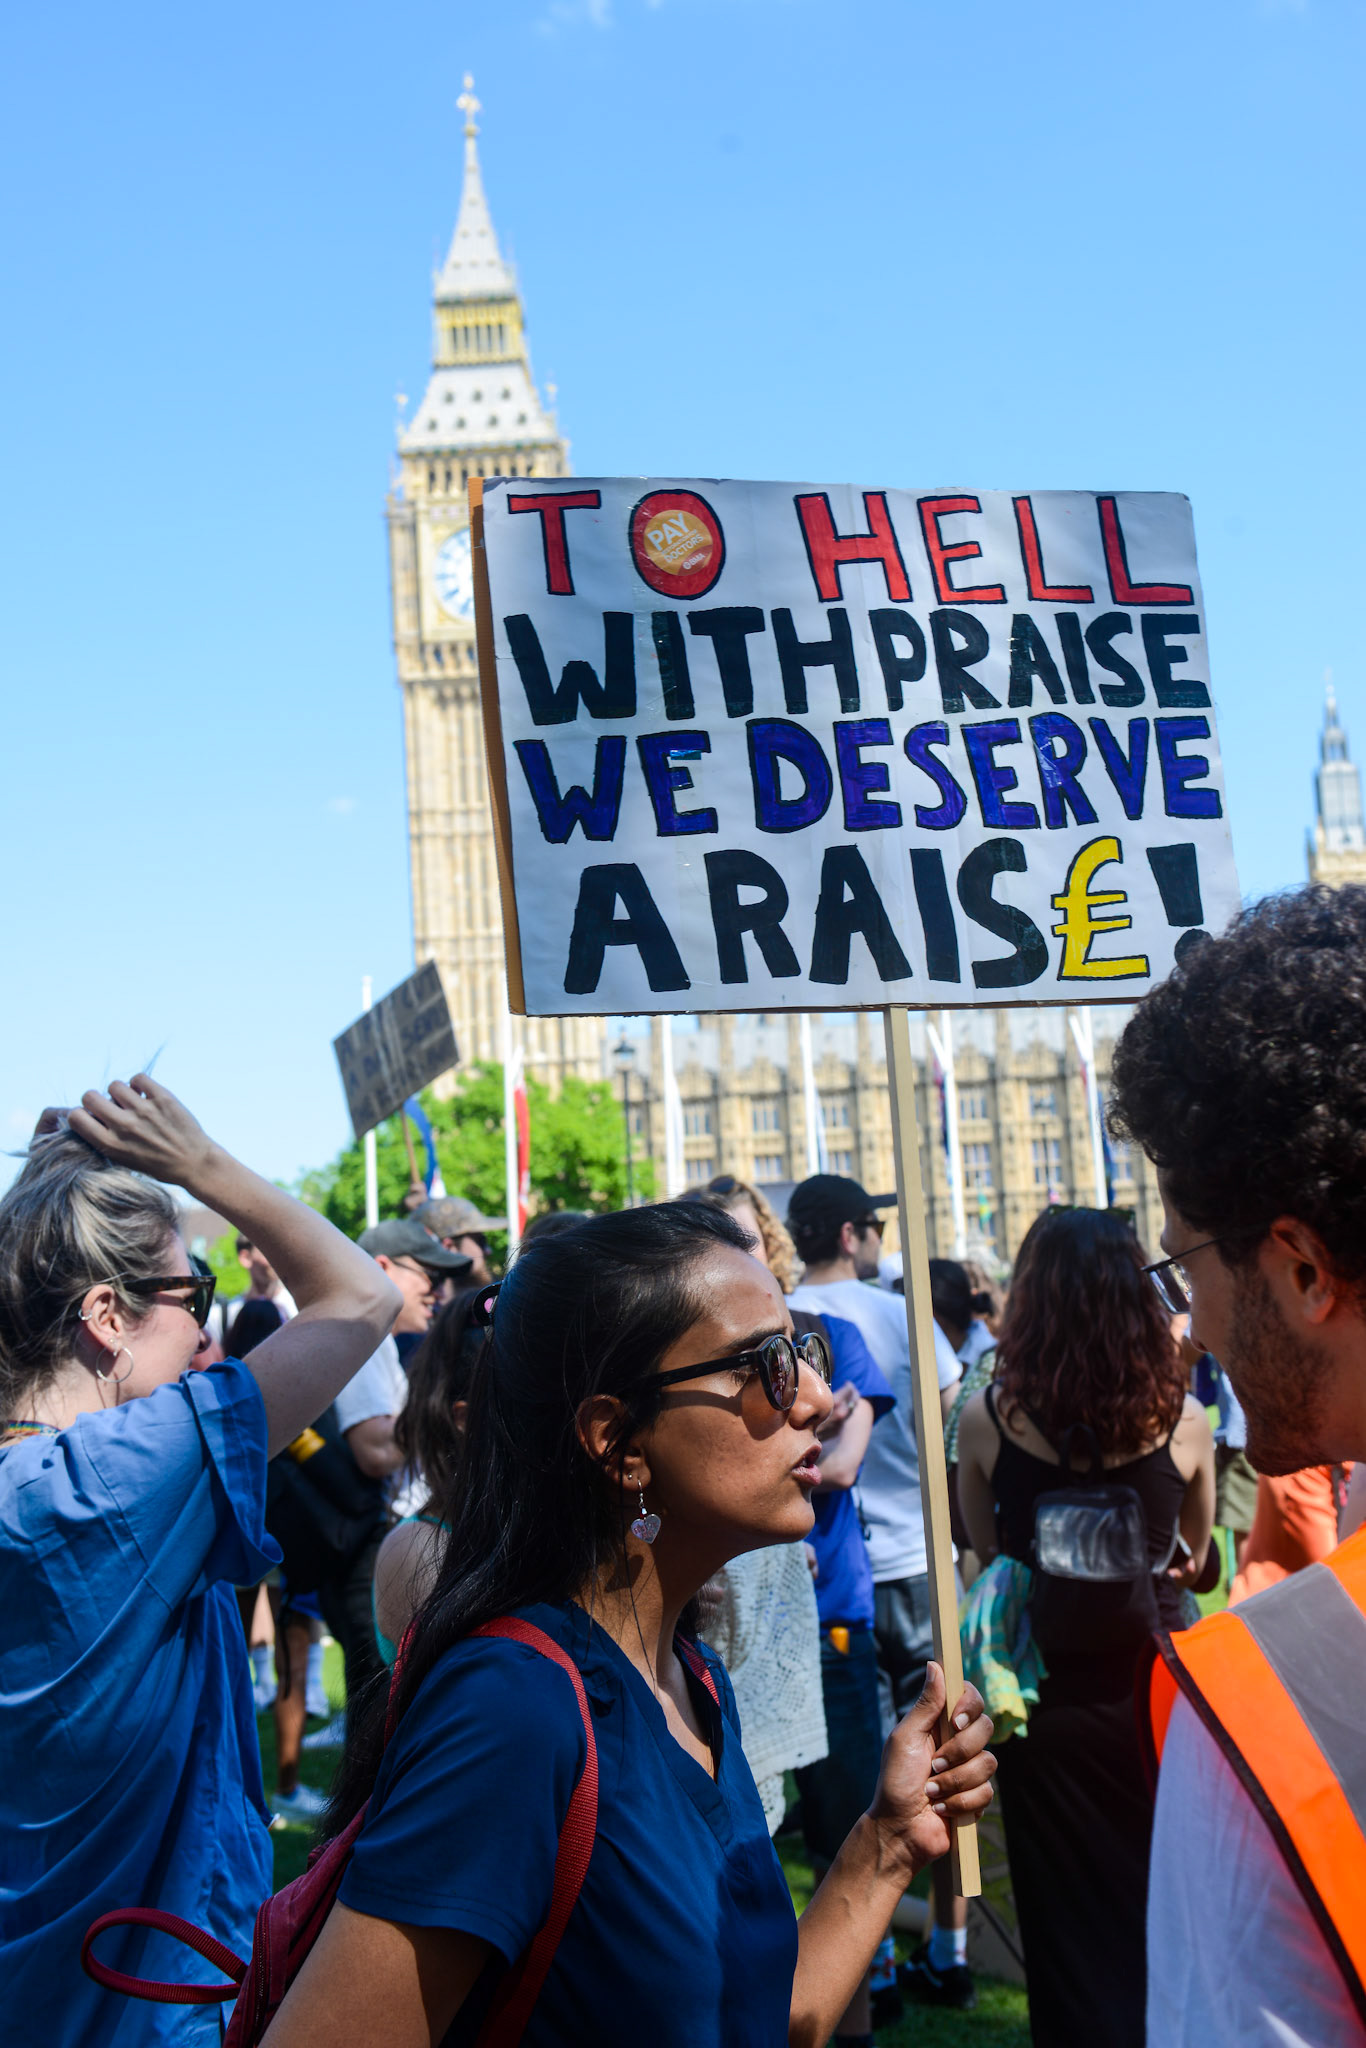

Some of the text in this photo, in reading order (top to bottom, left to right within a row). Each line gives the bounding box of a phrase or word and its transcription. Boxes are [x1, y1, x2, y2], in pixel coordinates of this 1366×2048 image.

[508, 489, 1195, 606] TO HELL
[647, 512, 689, 551] PAY
[664, 533, 704, 563] DOCTORS
[503, 606, 1212, 725] WITH PRAISE
[514, 711, 1223, 844] WE DESERVE
[564, 862, 690, 994] A
